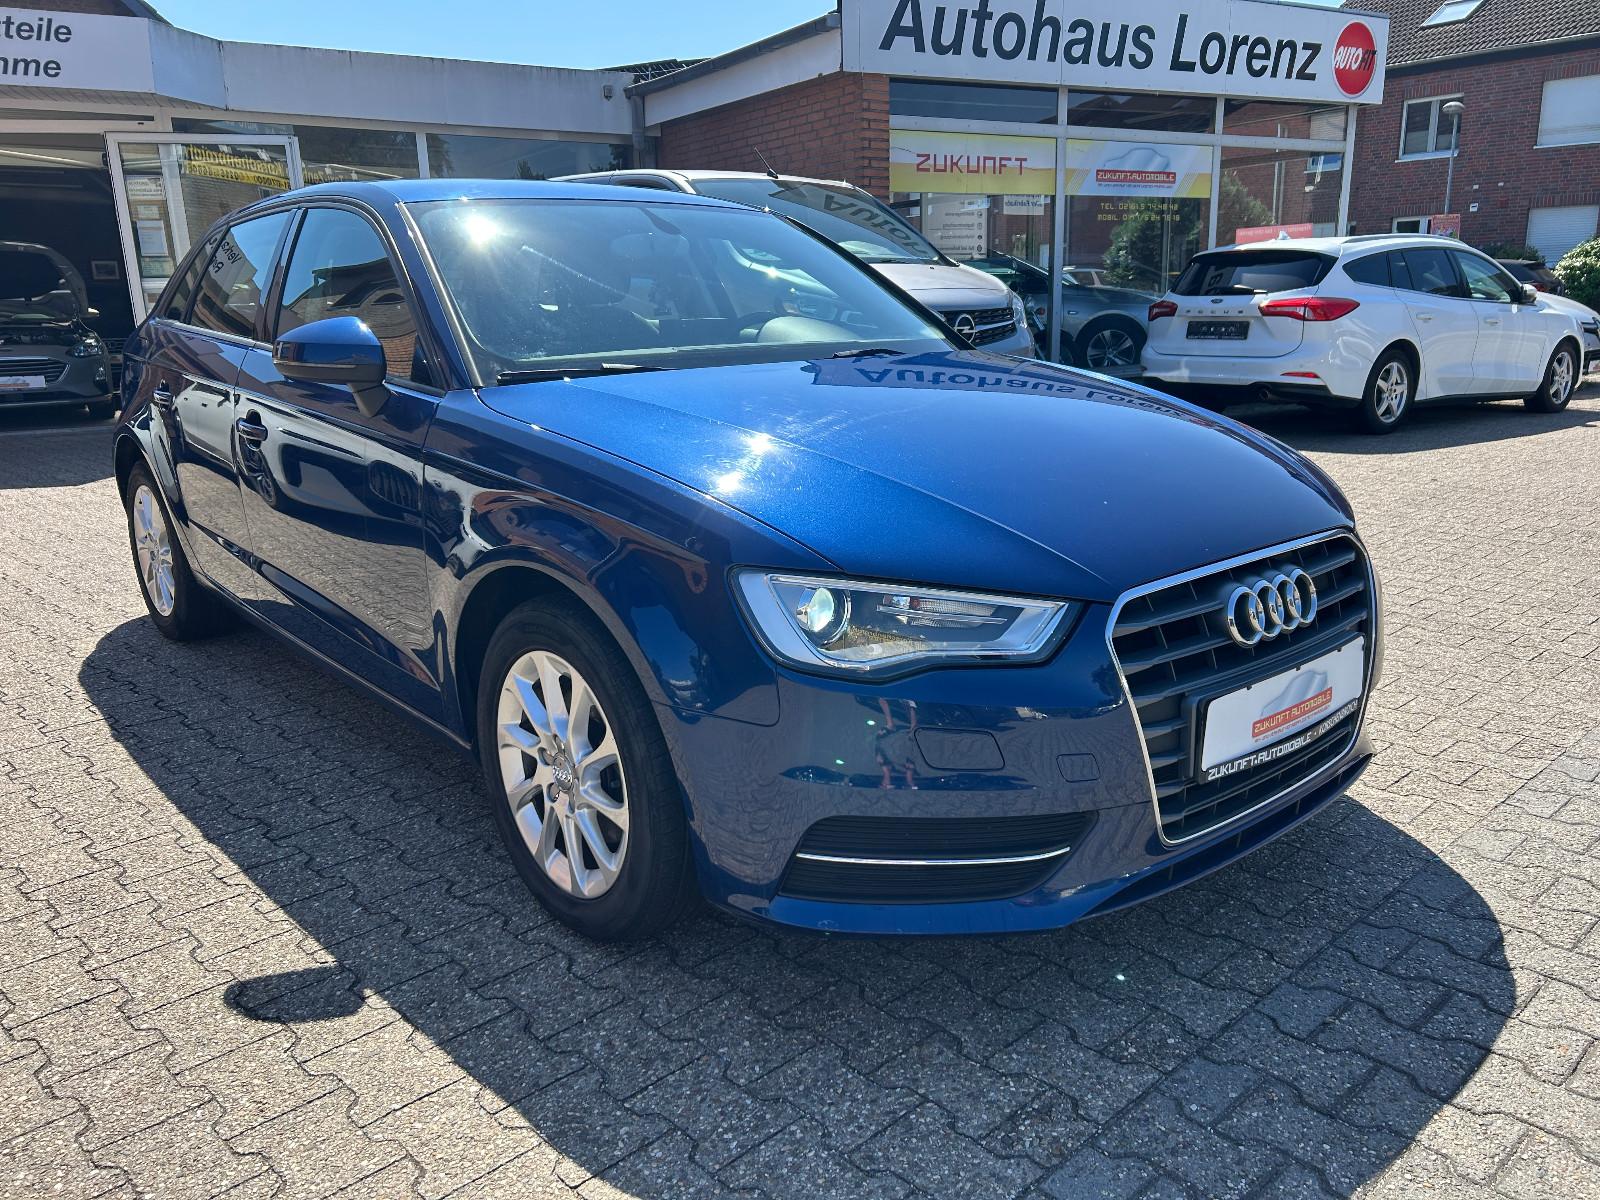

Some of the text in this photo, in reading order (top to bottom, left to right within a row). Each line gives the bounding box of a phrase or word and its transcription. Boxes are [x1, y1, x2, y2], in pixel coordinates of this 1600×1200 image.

[0, 15, 72, 43] teile
[878, 0, 1322, 81] Autohaus Lorenz
[1334, 45, 1377, 71] AUTOFIT
[916, 153, 1028, 175] ZUKUNFT
[1207, 732, 1312, 781] ZUKUNFT.AUTOMOBILE
